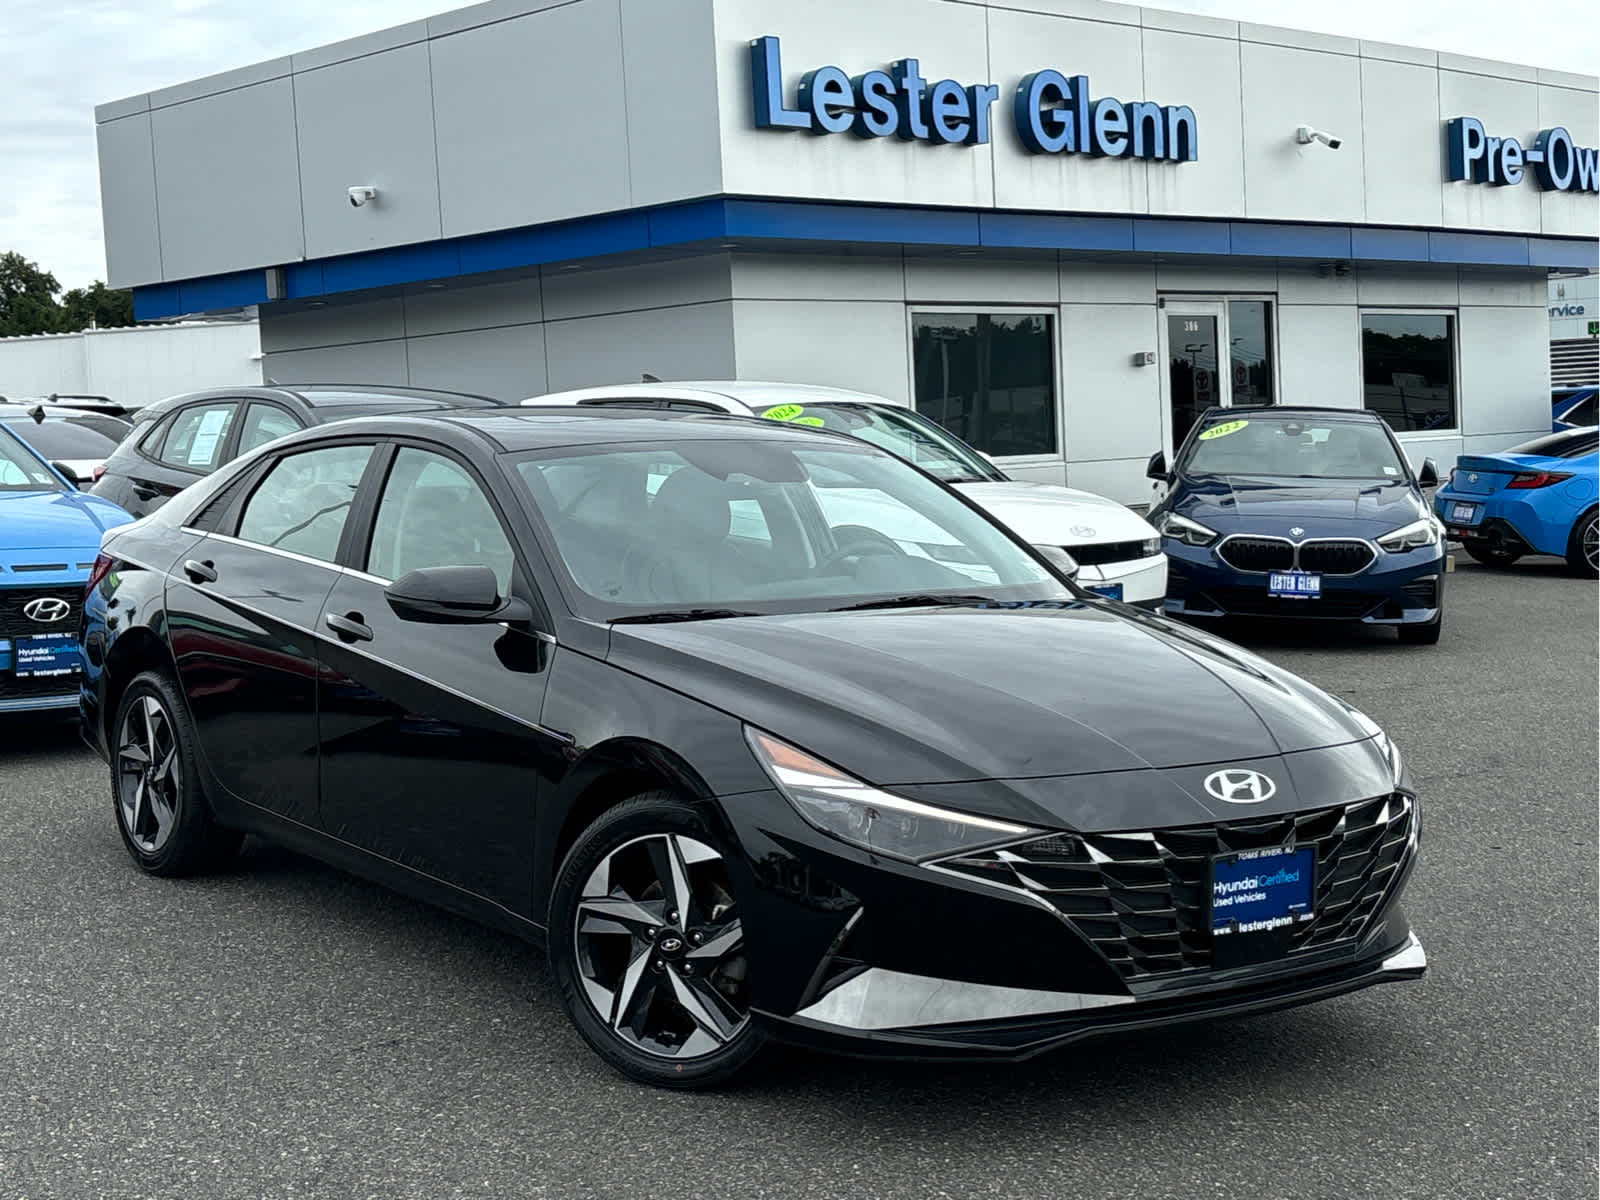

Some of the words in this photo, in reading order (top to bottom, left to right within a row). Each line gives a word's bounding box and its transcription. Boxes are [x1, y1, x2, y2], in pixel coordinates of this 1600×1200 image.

[751, 36, 999, 145] Lester
[1015, 68, 1198, 163] Glenn
[1208, 422, 1241, 438] 2022
[1270, 574, 1296, 591] LESTER
[1297, 575, 1320, 592] GLENN
[19, 648, 48, 657] Hyundai
[1239, 851, 1258, 860] TOMS
[1213, 875, 1259, 896] Hyundai
[1259, 868, 1299, 887] Certified
[1213, 897, 1233, 907] Used
[1234, 892, 1267, 904] Vehicles
[1239, 917, 1292, 932] lesterglenn
